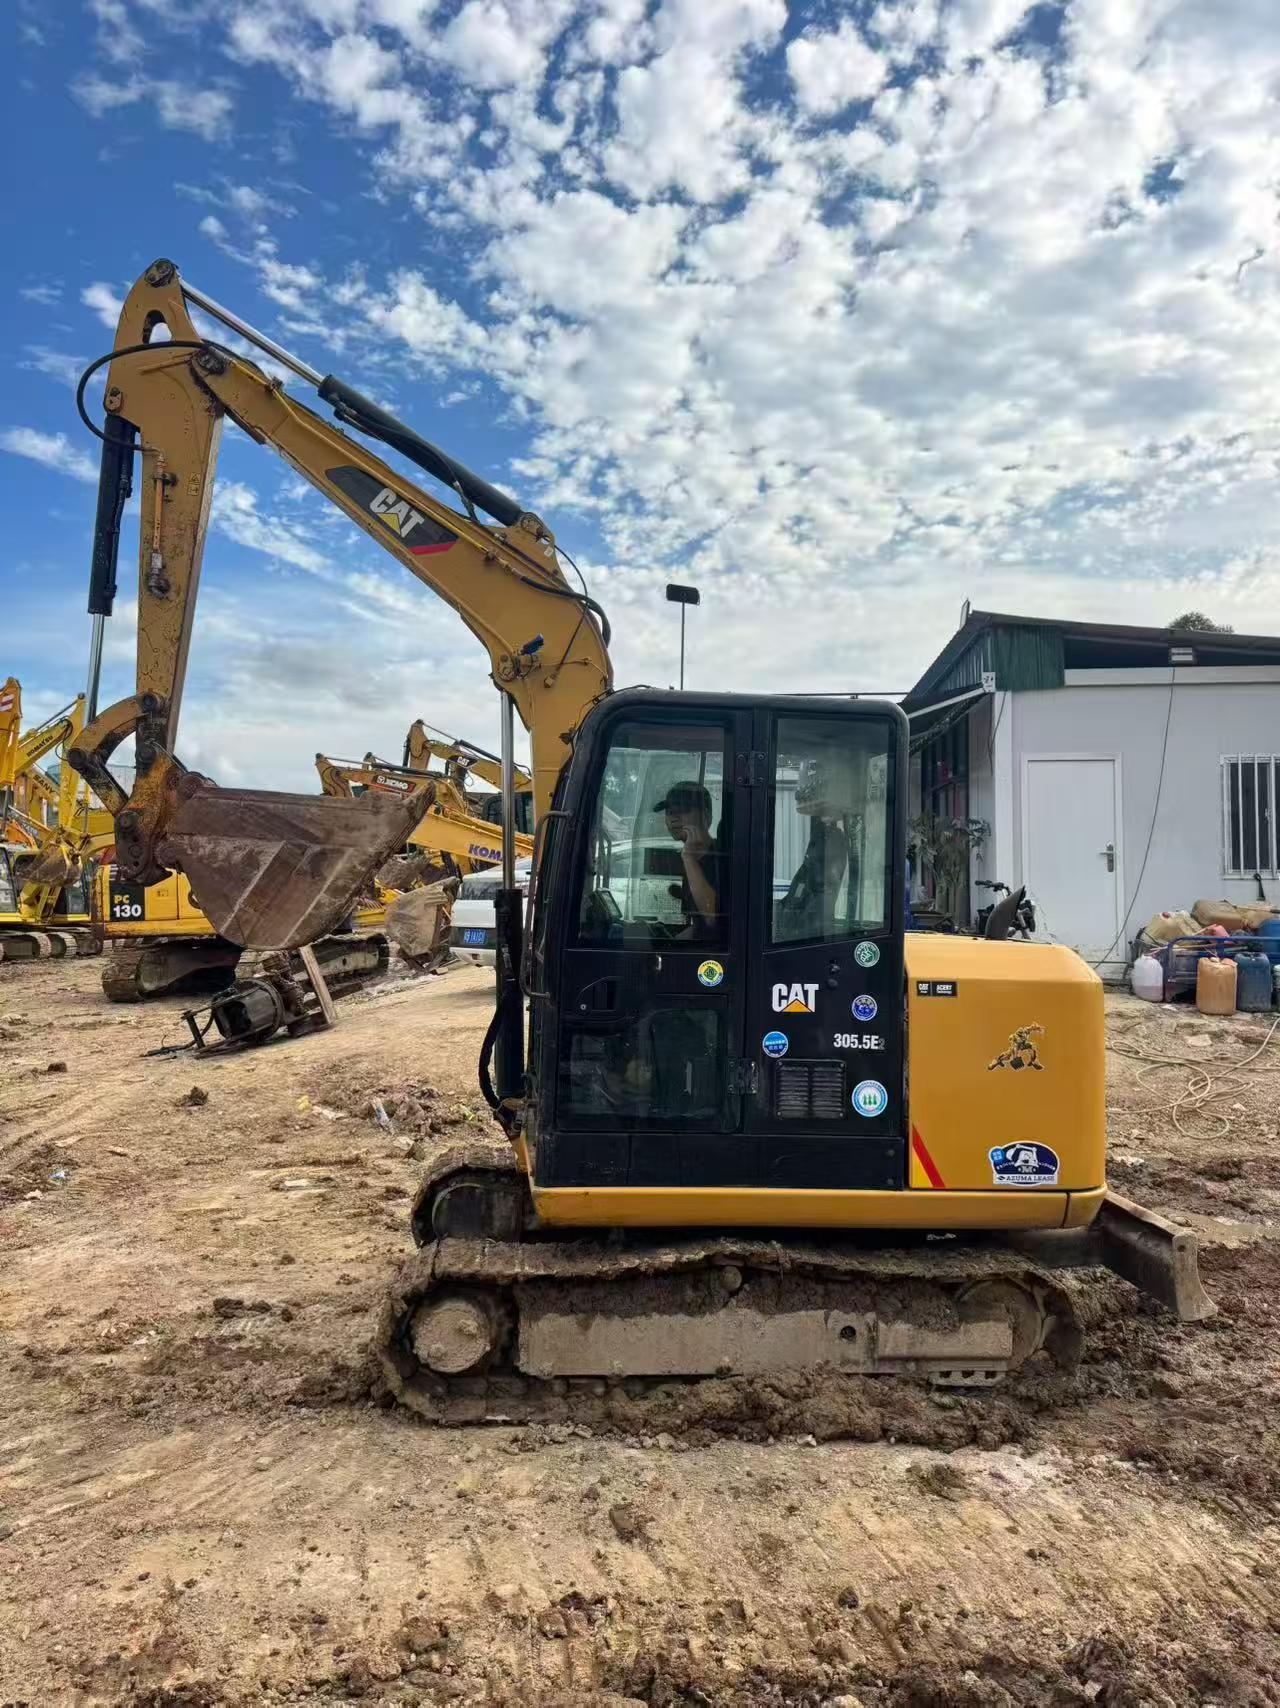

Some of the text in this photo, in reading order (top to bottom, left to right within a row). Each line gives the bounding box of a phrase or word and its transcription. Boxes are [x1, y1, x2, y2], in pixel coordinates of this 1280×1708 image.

[370, 487, 425, 538] CAT
[33, 774, 57, 794] SANY
[113, 894, 130, 904] PC
[113, 904, 142, 918] 130
[772, 983, 819, 1013] CAT
